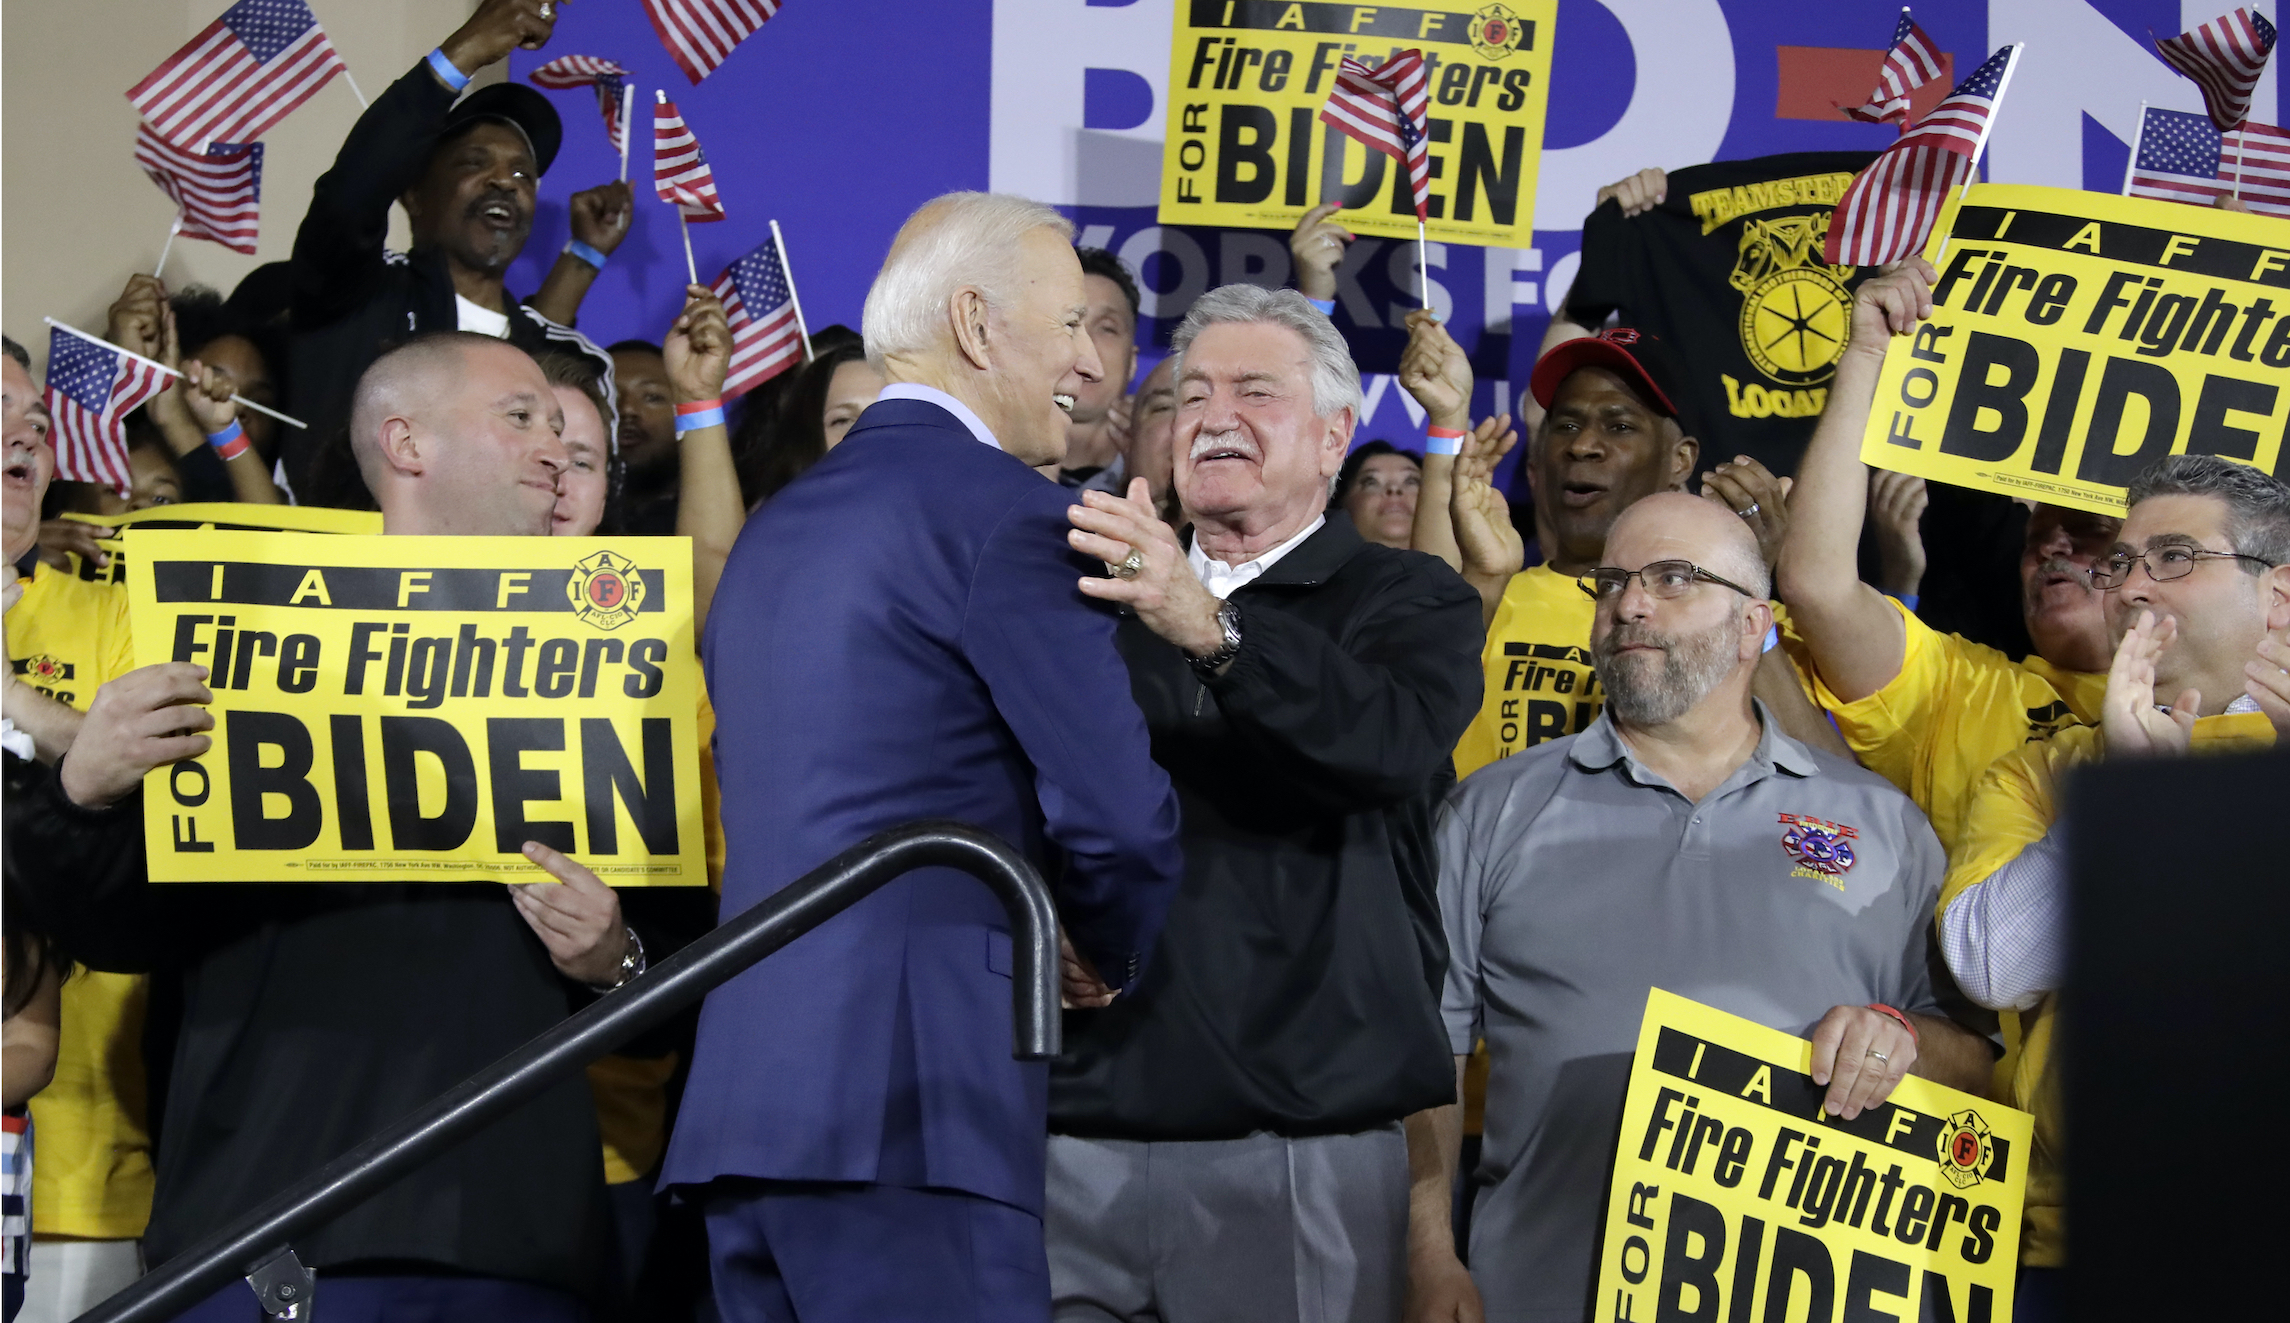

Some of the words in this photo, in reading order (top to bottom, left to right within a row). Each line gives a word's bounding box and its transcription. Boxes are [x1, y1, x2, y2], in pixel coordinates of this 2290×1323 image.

[1187, 37, 1293, 92] Fire
[1178, 102, 1209, 204] FOR
[1932, 248, 2078, 326] Fire
[1887, 323, 1953, 451] FOR
[1939, 330, 2290, 488] BIDE
[171, 614, 322, 694] Fire
[345, 621, 666, 710] Fighters
[1504, 660, 1576, 694] Fire
[226, 710, 680, 855] BIDEN
[1638, 1086, 1754, 1188] Fire
[1758, 1126, 2001, 1265] Fighters
